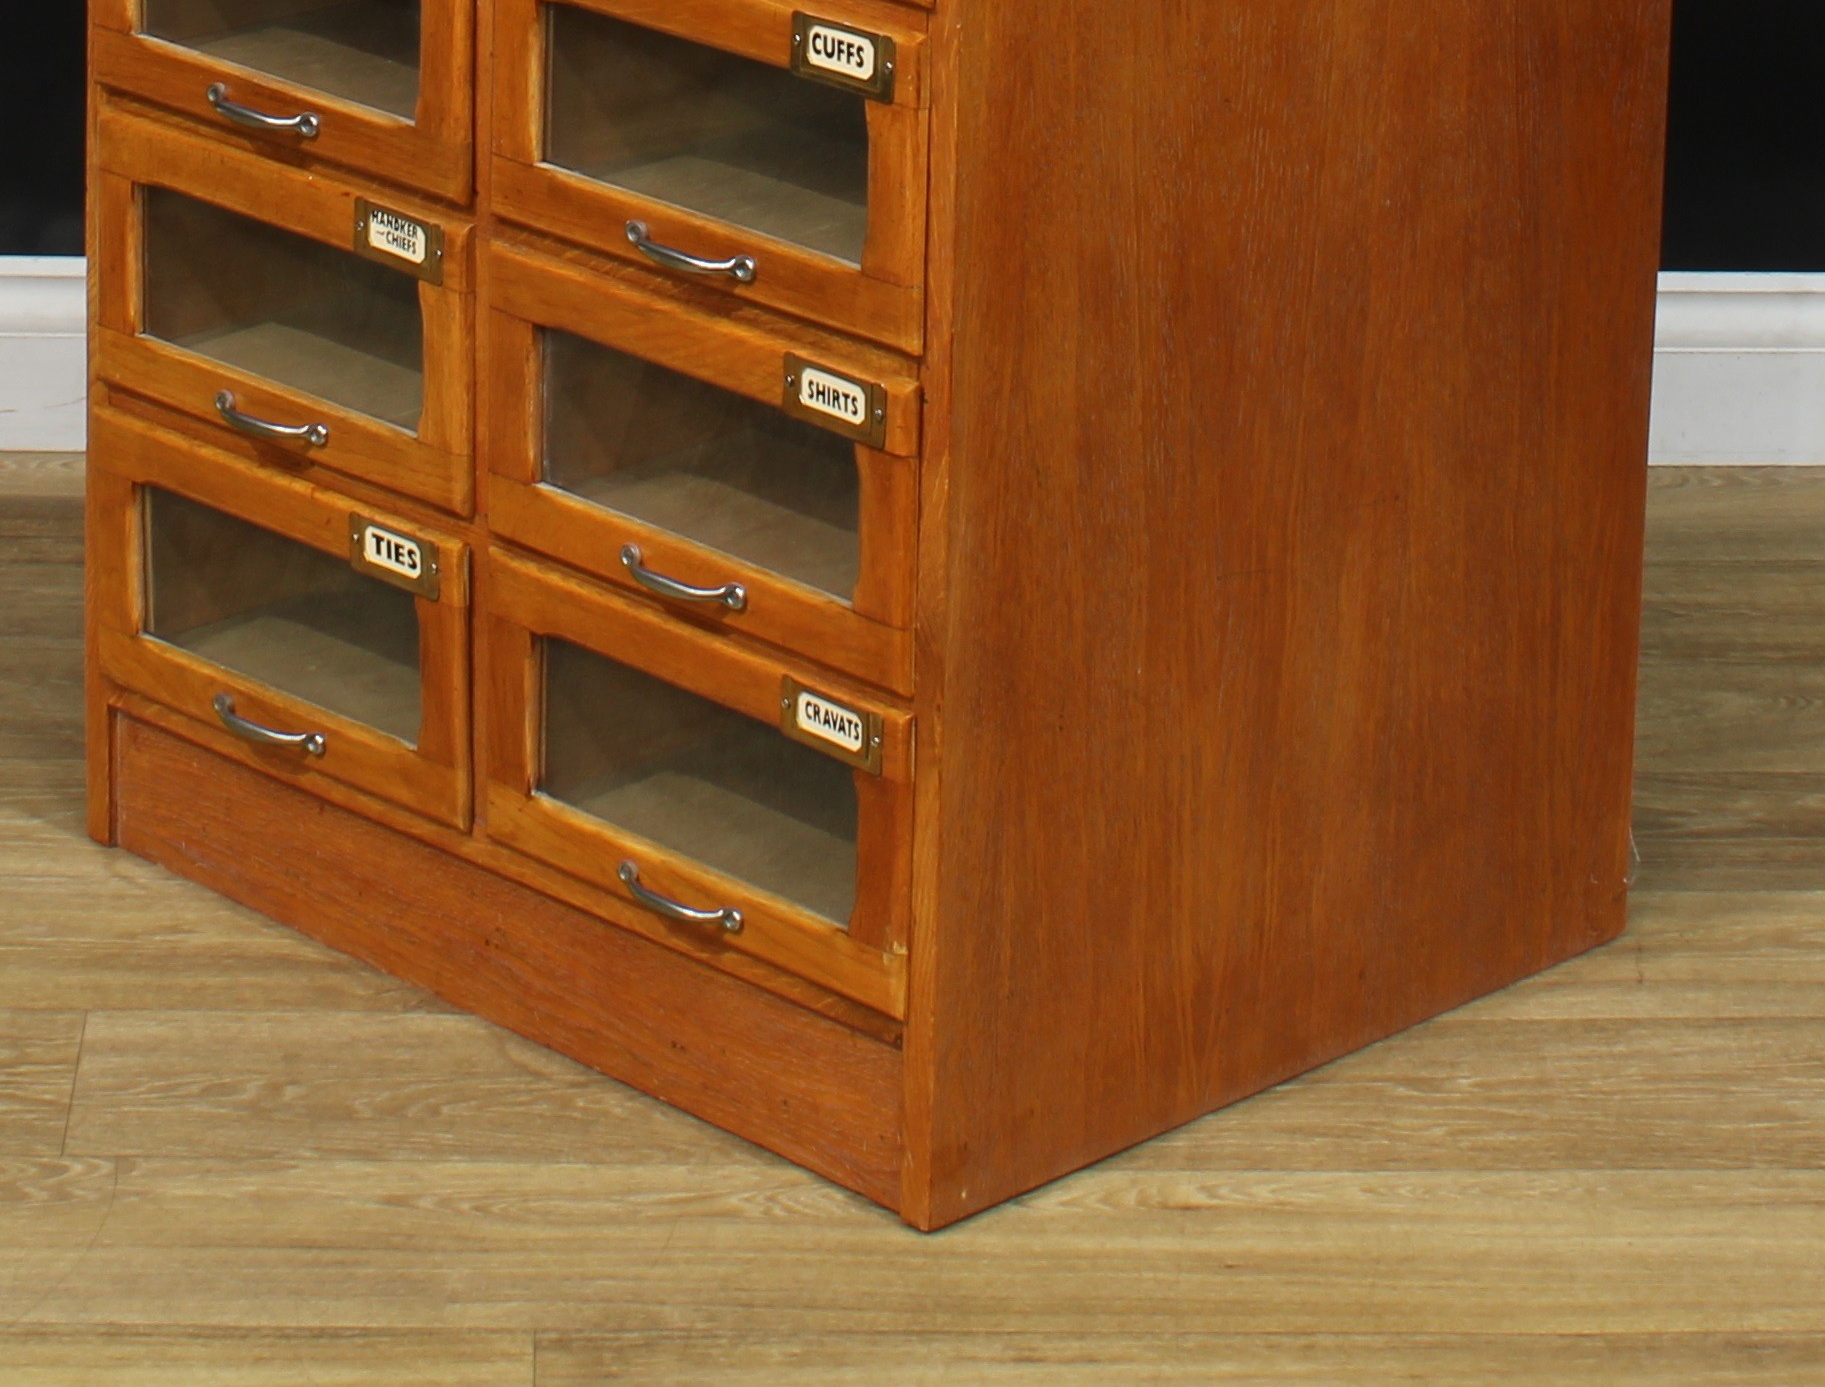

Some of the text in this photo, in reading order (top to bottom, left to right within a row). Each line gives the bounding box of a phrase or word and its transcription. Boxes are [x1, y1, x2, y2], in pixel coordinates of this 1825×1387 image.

[811, 32, 865, 68] CUFFS
[371, 209, 418, 239] HANDKER
[807, 379, 859, 416] SHIRTS
[371, 532, 418, 570] TIES
[804, 700, 861, 742] CRAVATS
